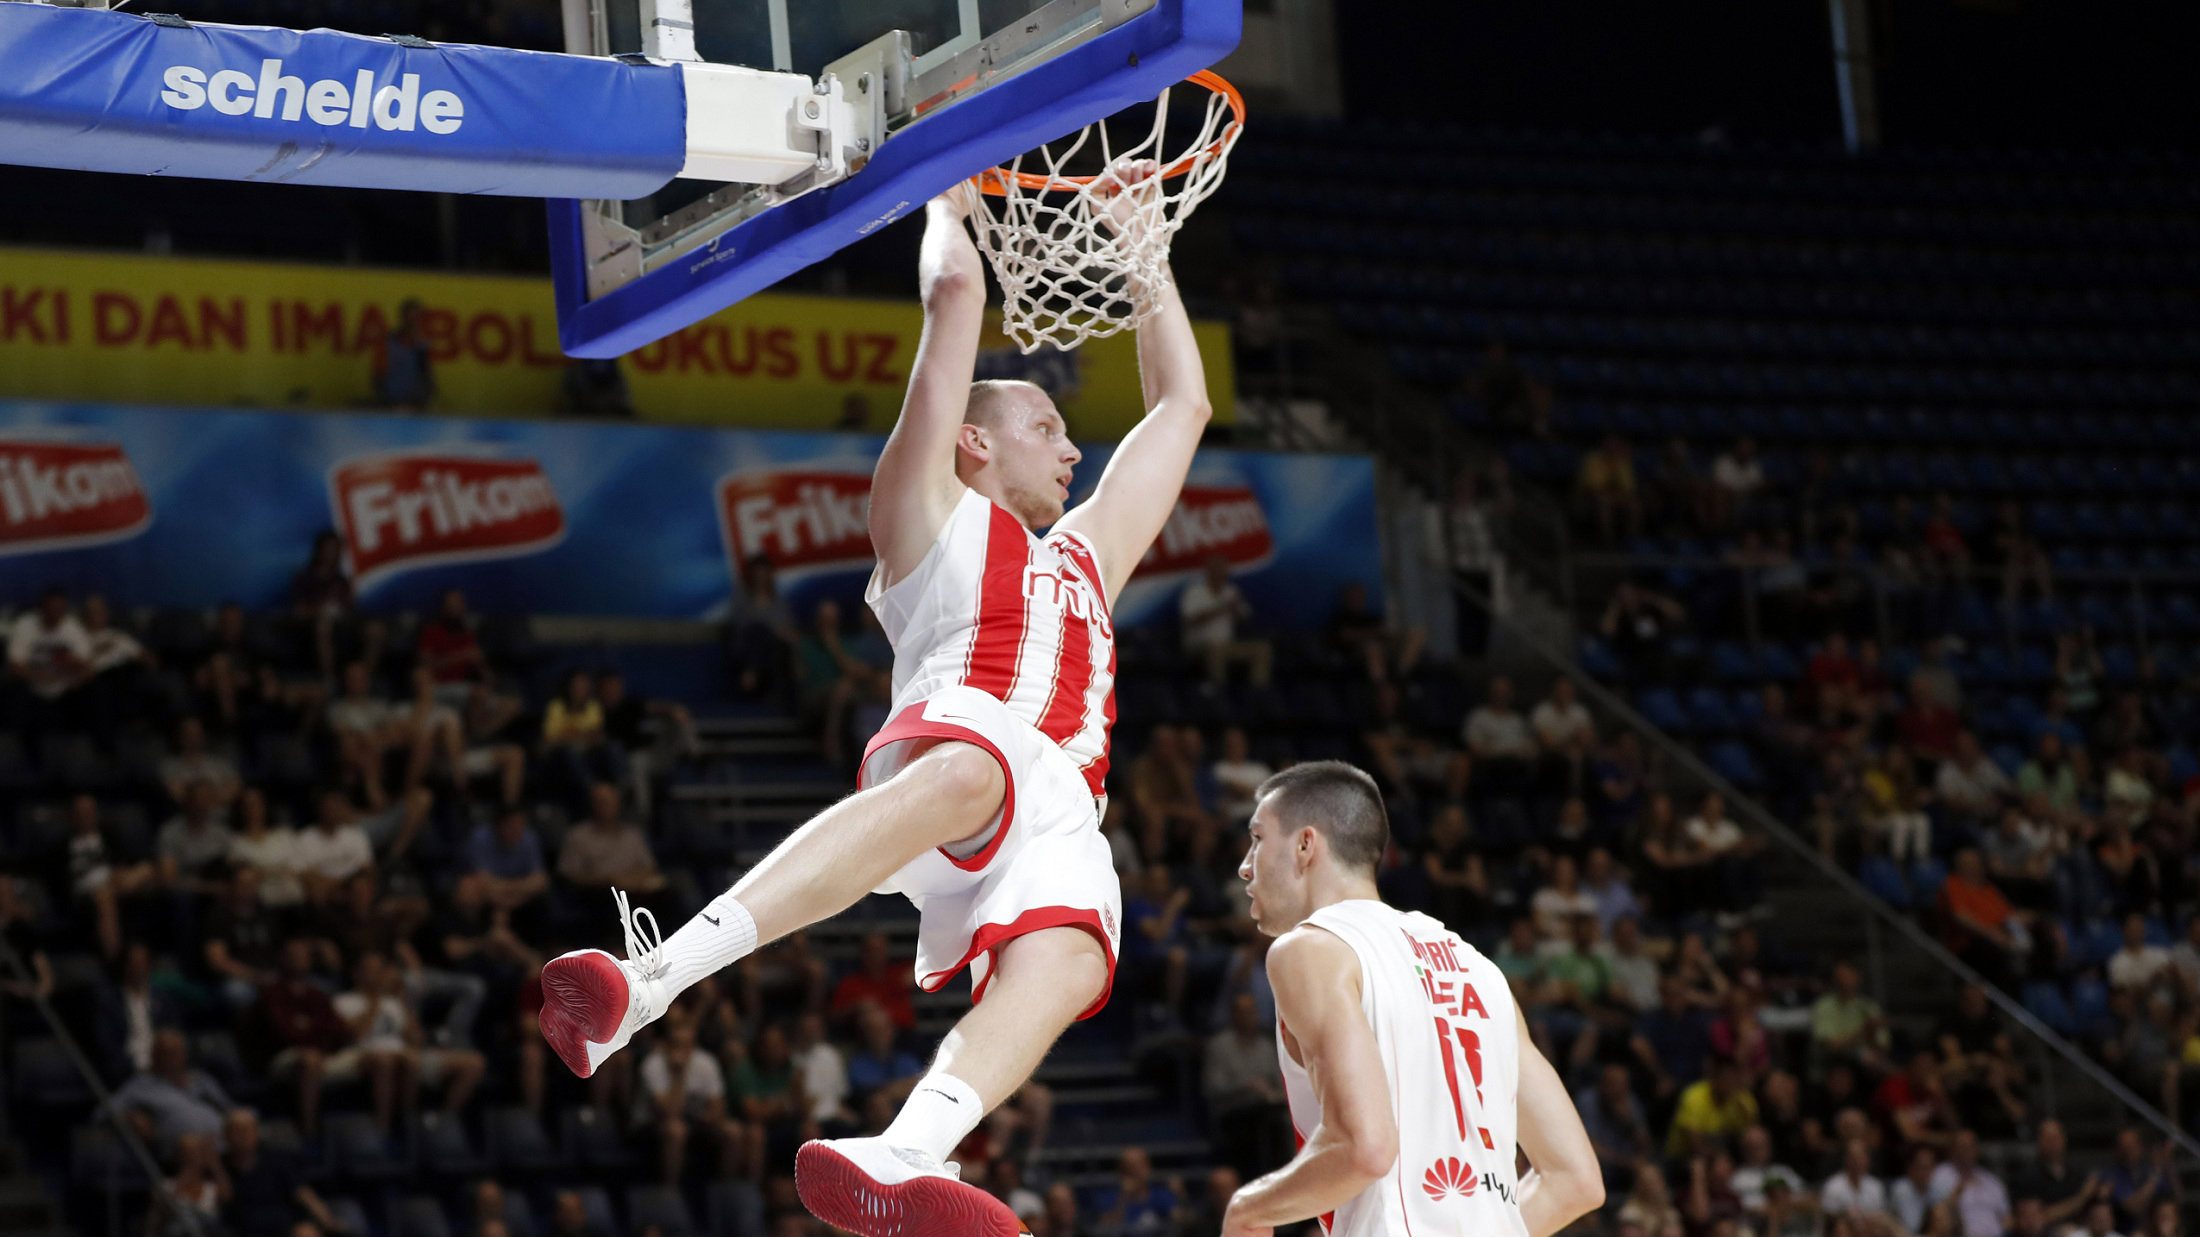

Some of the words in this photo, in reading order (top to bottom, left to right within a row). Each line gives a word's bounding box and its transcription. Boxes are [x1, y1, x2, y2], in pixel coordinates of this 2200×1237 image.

[161, 59, 464, 134] schelde
[93, 291, 247, 352] DAN
[419, 308, 577, 367] BOL
[817, 331, 901, 385] UZ
[736, 485, 869, 556] Frik
